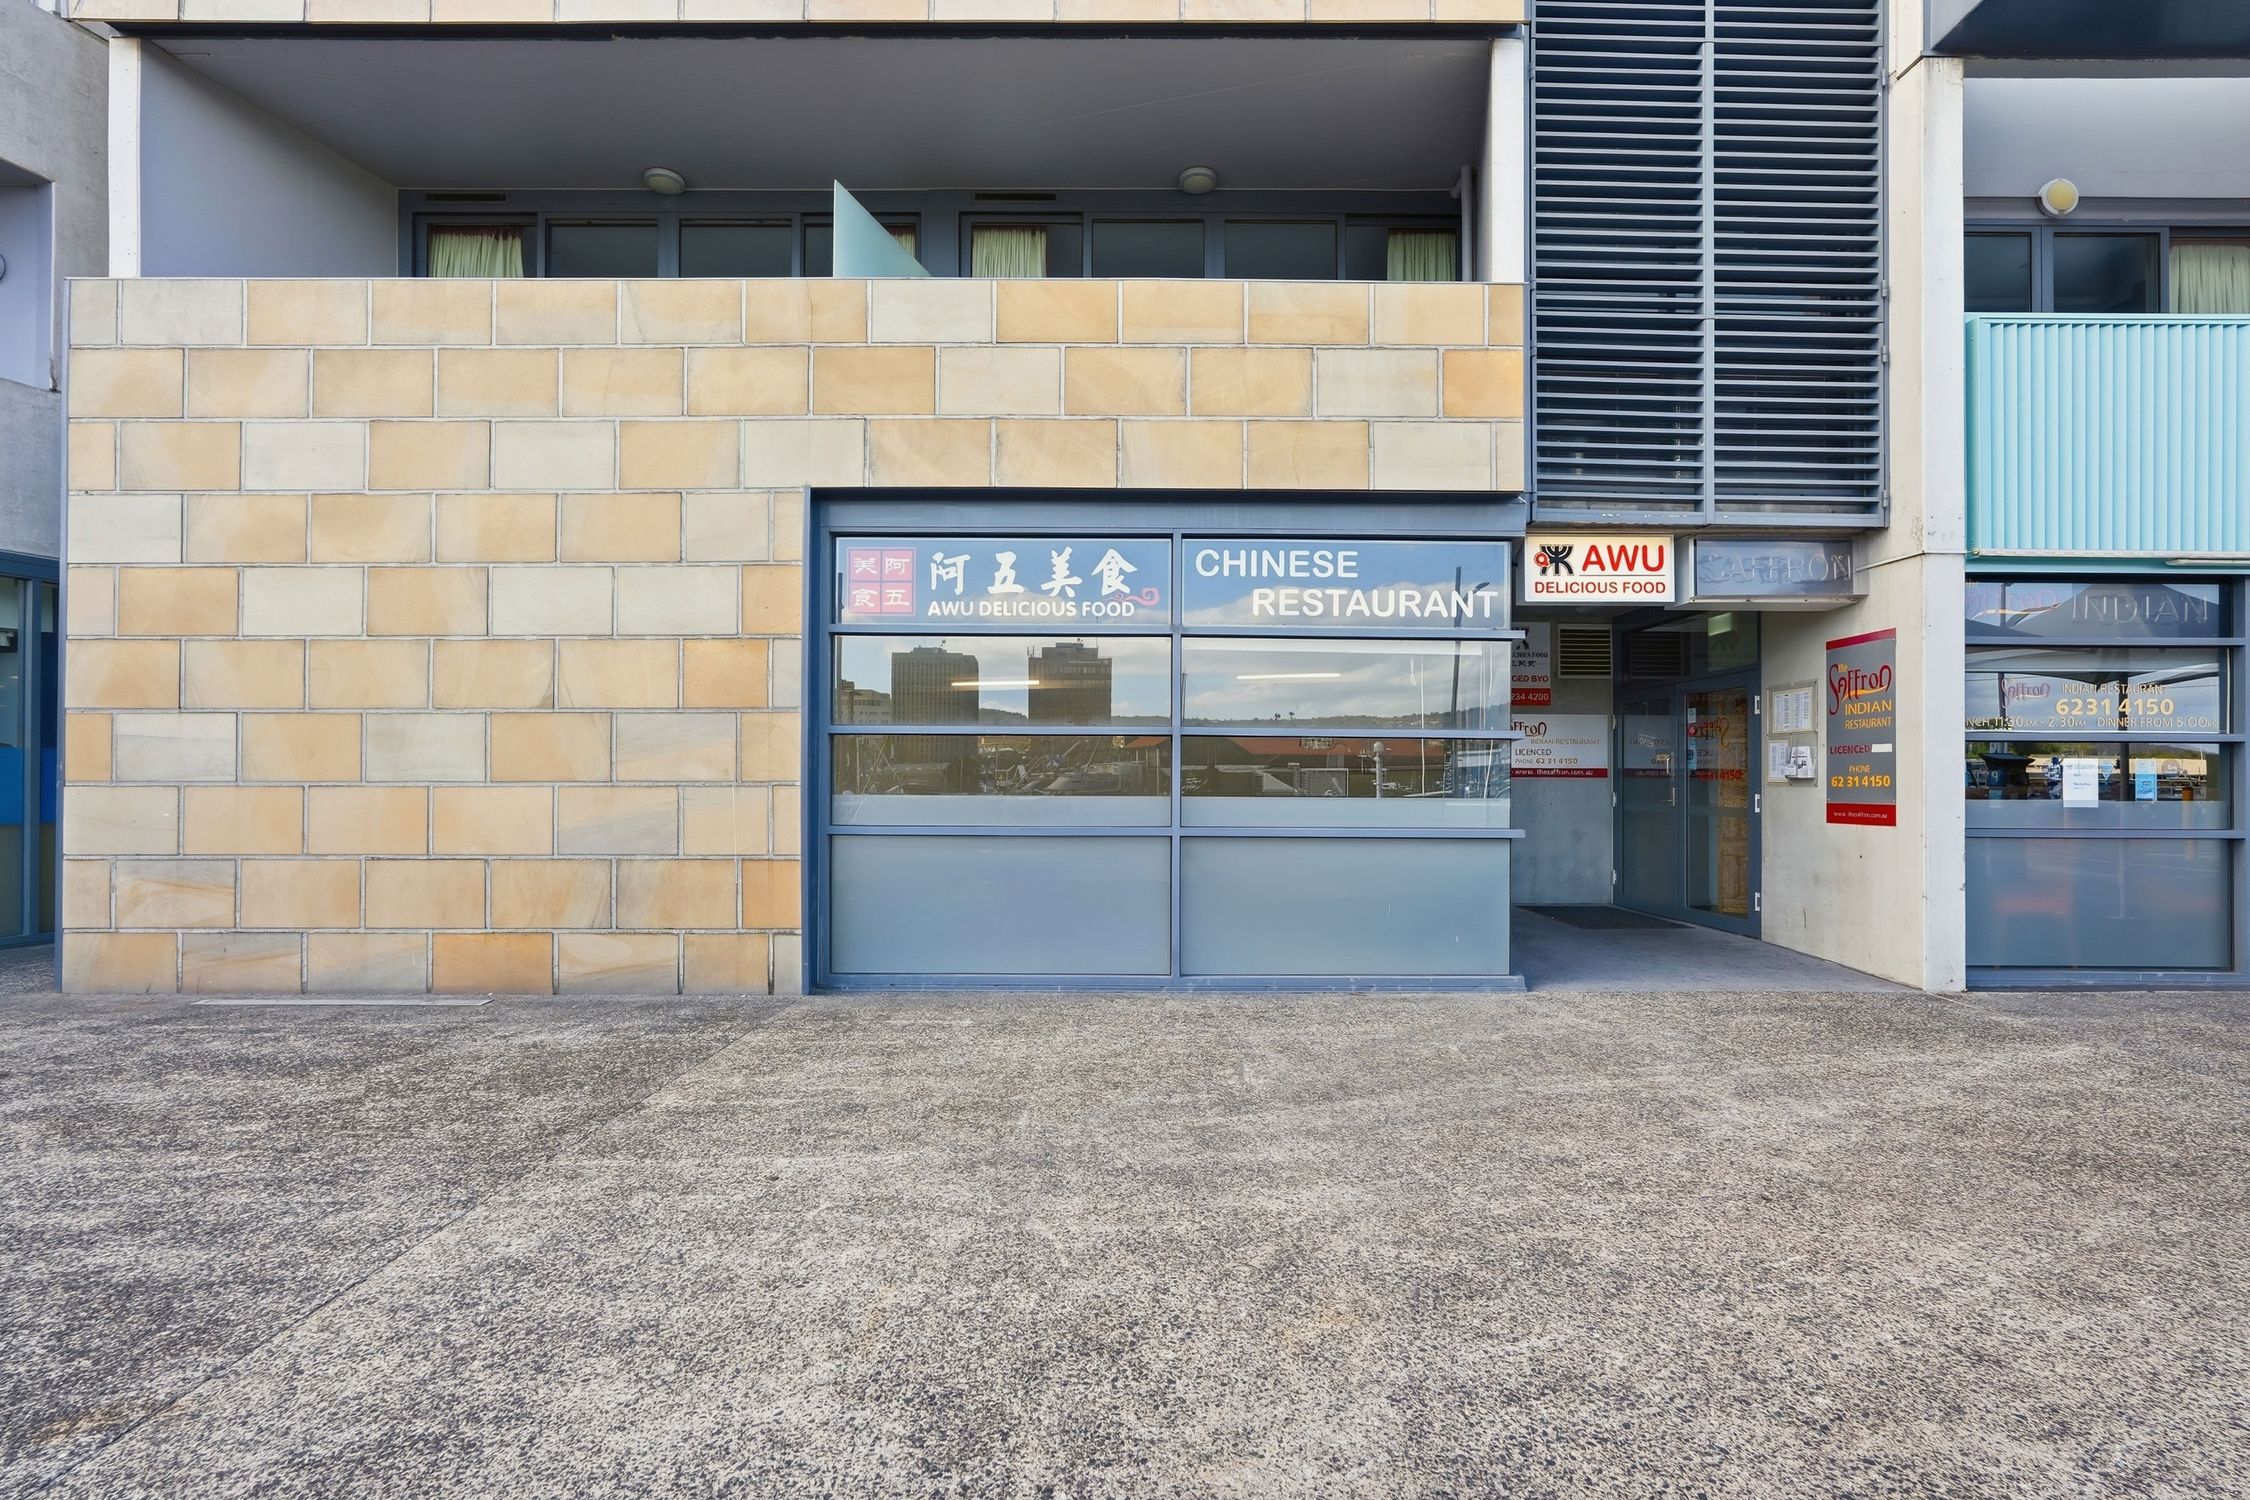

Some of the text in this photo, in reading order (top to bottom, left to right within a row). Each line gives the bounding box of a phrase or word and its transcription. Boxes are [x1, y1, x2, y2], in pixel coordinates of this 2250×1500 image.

[1195, 549, 1359, 578] CHINESE
[1581, 544, 1665, 571] AWU
[929, 547, 1138, 598] 阿五美食
[1702, 553, 1851, 582] SAFFRON
[1534, 581, 1666, 594] DELICIOUS FOOD
[928, 601, 1135, 617] AWU DELICIOUS FOOD
[1252, 588, 1498, 618] RESTAURANT
[2072, 594, 2208, 623] INDIAN
[1531, 674, 1549, 683] BYO
[2063, 683, 2167, 694] INDIAN RESTAURANT
[1844, 699, 1892, 716] INDIAN
[2055, 698, 2175, 716] 6231 4150
[1844, 716, 1893, 729] RESTAURANT
[2097, 717, 2138, 728] DINNER
[2140, 717, 2173, 728] FROM
[1515, 748, 1552, 756] LICENCED
[1830, 744, 1870, 755] LICENCED
[1849, 764, 1870, 773] PHONE
[1861, 775, 1891, 788] 4150
